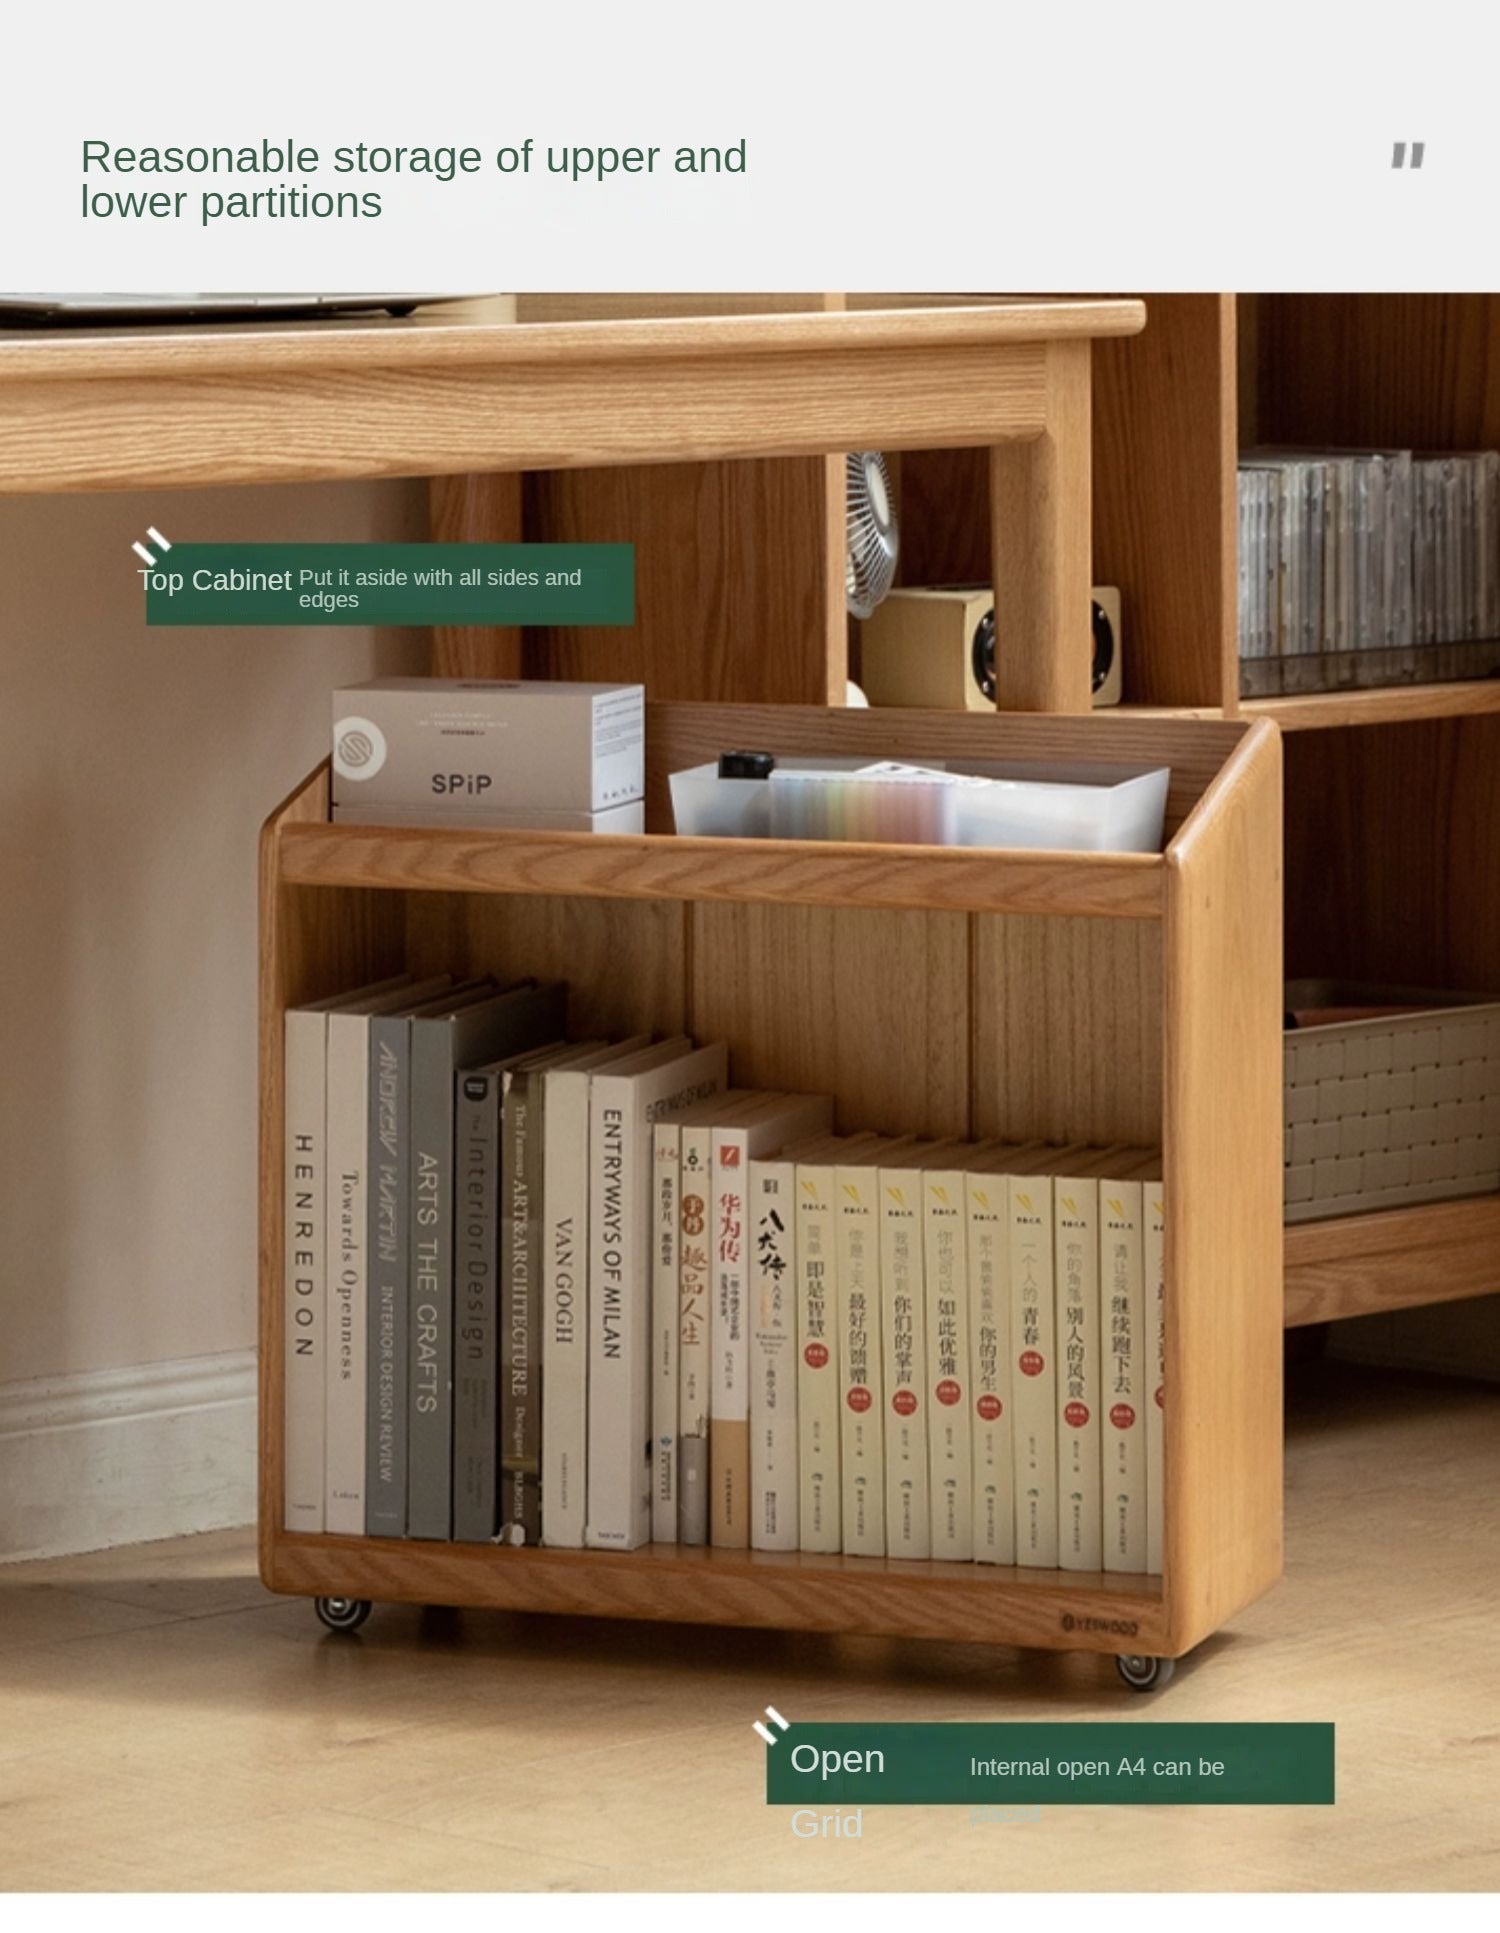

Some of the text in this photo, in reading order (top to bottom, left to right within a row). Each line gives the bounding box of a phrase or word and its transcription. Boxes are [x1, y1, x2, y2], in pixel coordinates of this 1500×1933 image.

[431, 773, 493, 794] SPiP
[379, 1163, 398, 1262] MARTIN
[468, 1137, 488, 1251] Interior
[602, 1109, 622, 1360] ENTRYWAYS OF MILAN
[720, 1193, 741, 1263] 华为传
[295, 1134, 314, 1356] HENREDON
[336, 1170, 359, 1380] Towards Openness
[416, 1151, 439, 1413] ARTS THE CRAFTS
[555, 1217, 574, 1344] VAN GOGH
[757, 1208, 786, 1280] 八犬传
[380, 1286, 394, 1359] INTERIOR
[460, 1260, 488, 1360] Design
[937, 1298, 957, 1376] 如此优雅
[1022, 1307, 1040, 1346] 青春
[1066, 1306, 1086, 1400] 别人的风景
[1111, 1296, 1132, 1395] 继续跑下去
[379, 1363, 393, 1420] DESIGN
[379, 1426, 393, 1483] REVIEW
